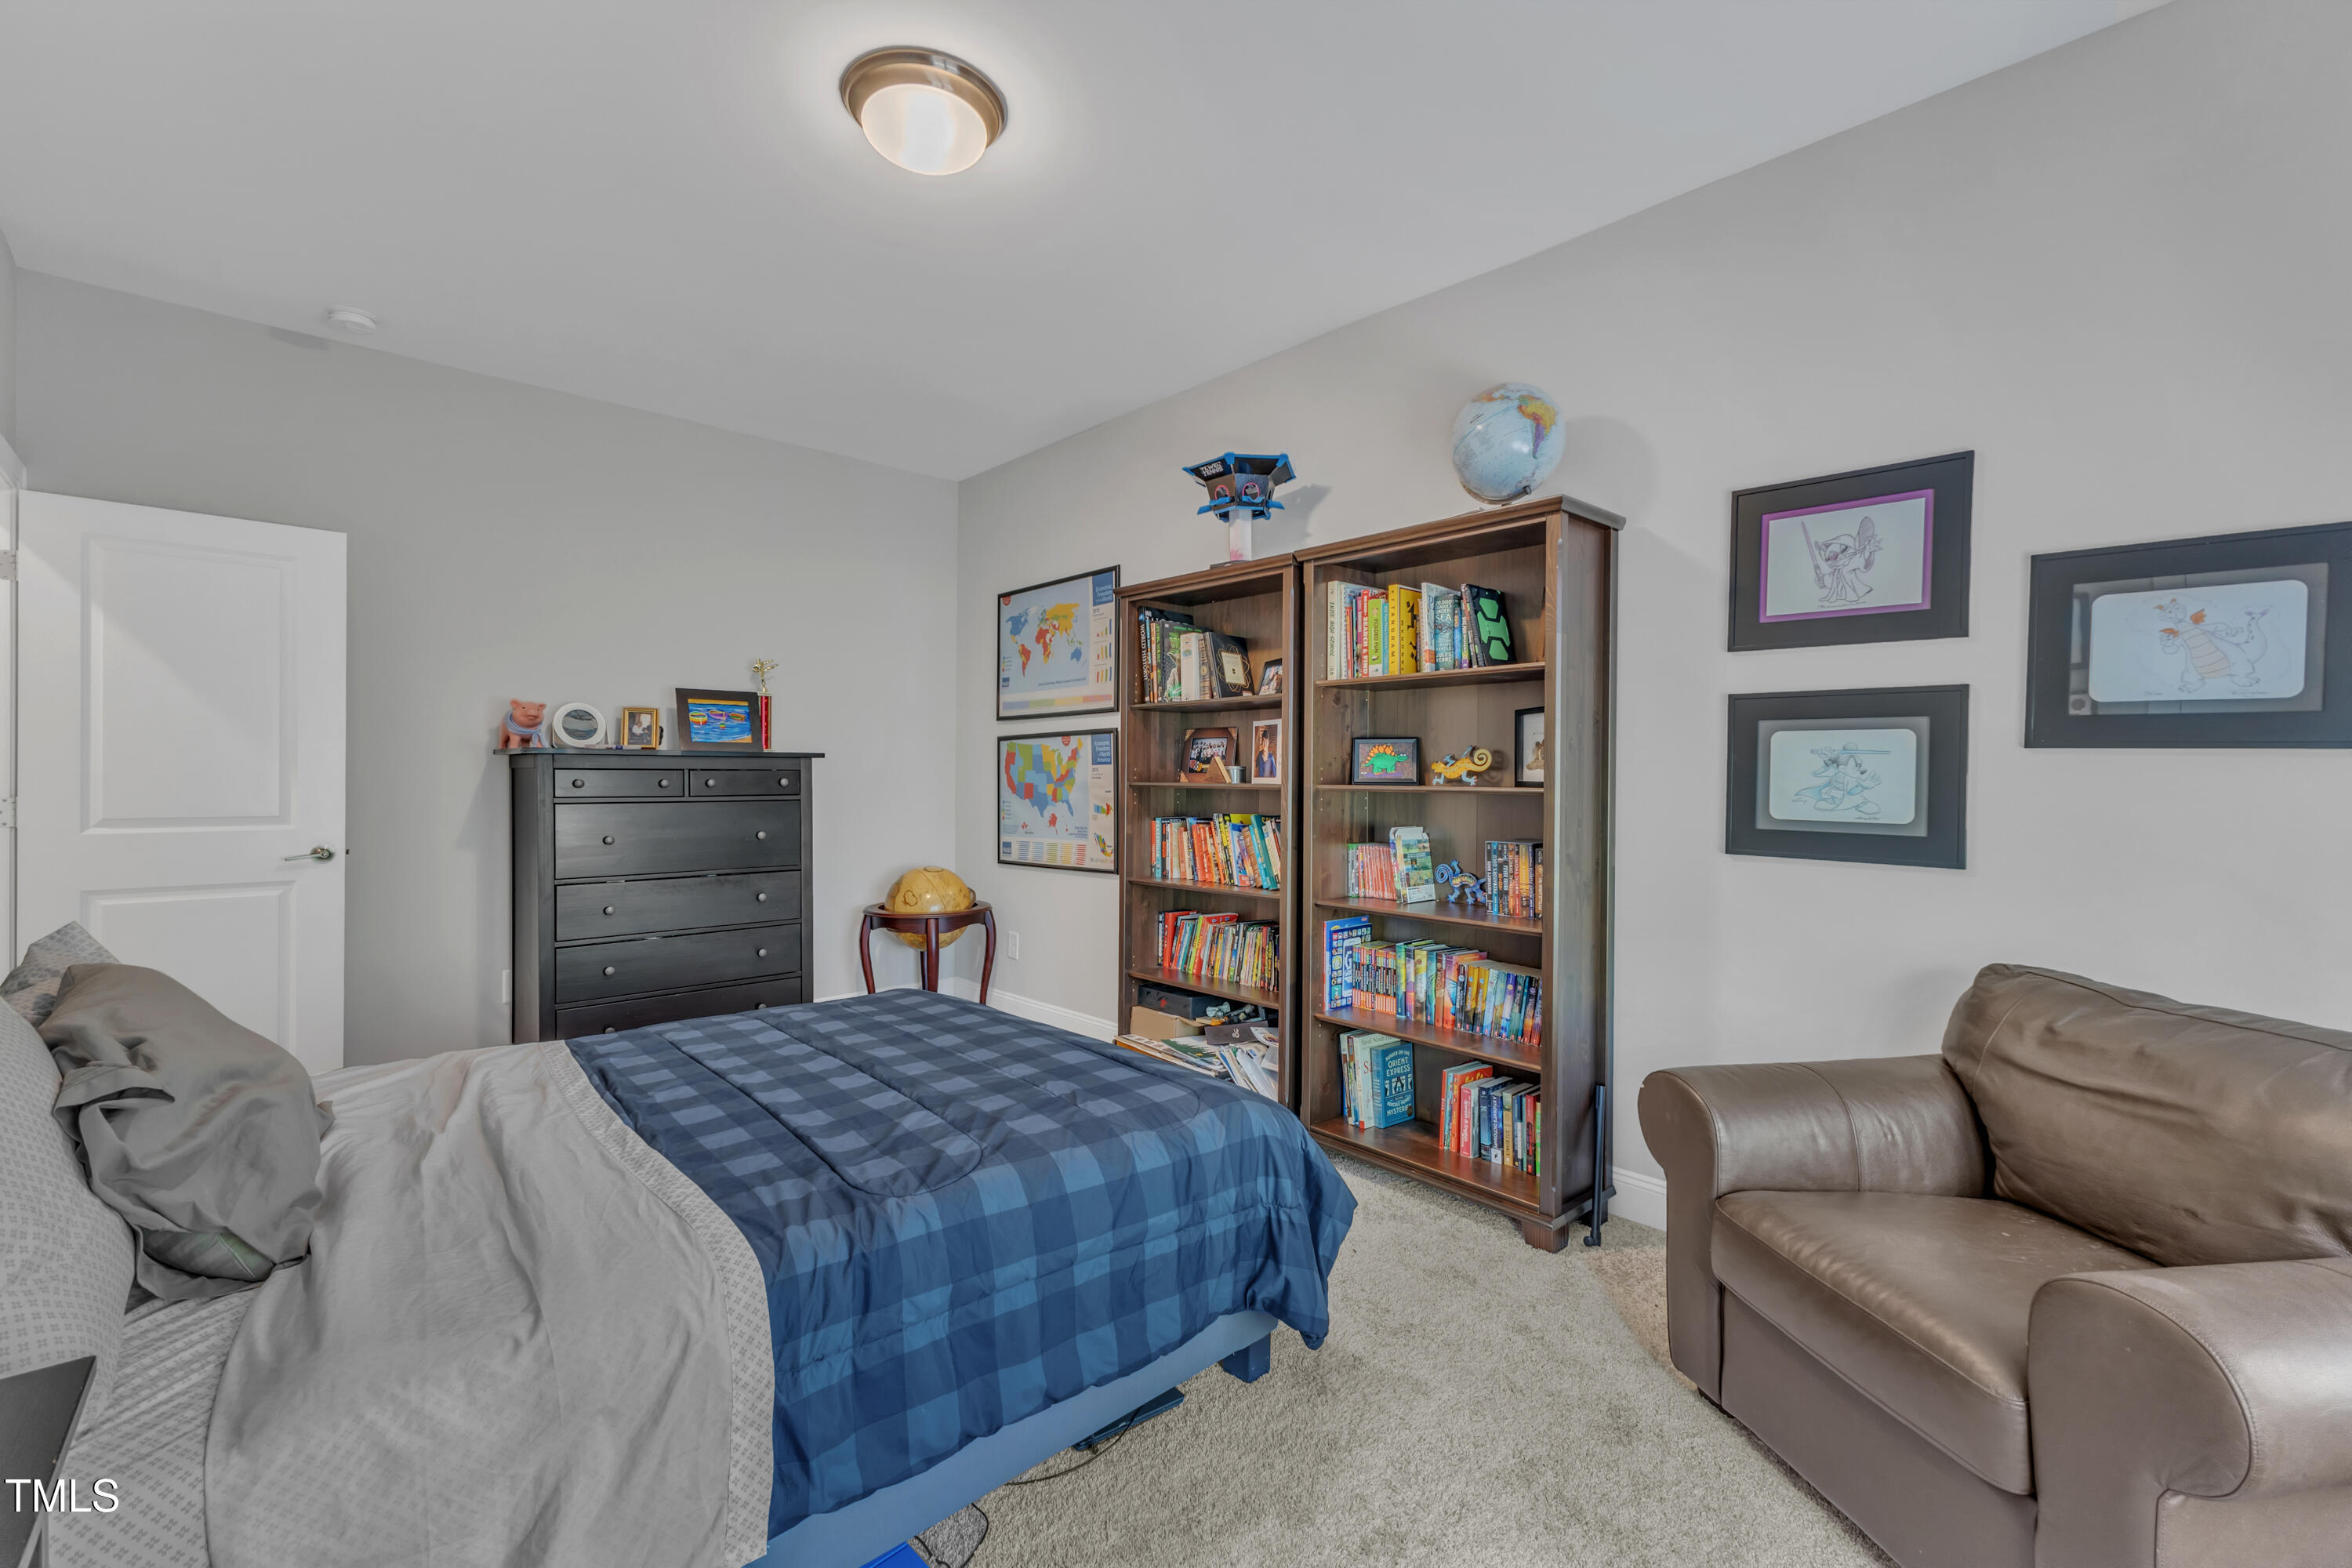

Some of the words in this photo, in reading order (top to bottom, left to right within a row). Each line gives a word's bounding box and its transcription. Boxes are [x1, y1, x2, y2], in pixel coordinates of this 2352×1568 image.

[1202, 466, 1224, 477] TENNIS
[1388, 1057, 1409, 1069] ORIENT
[1386, 1064, 1411, 1077] EXPRESS
